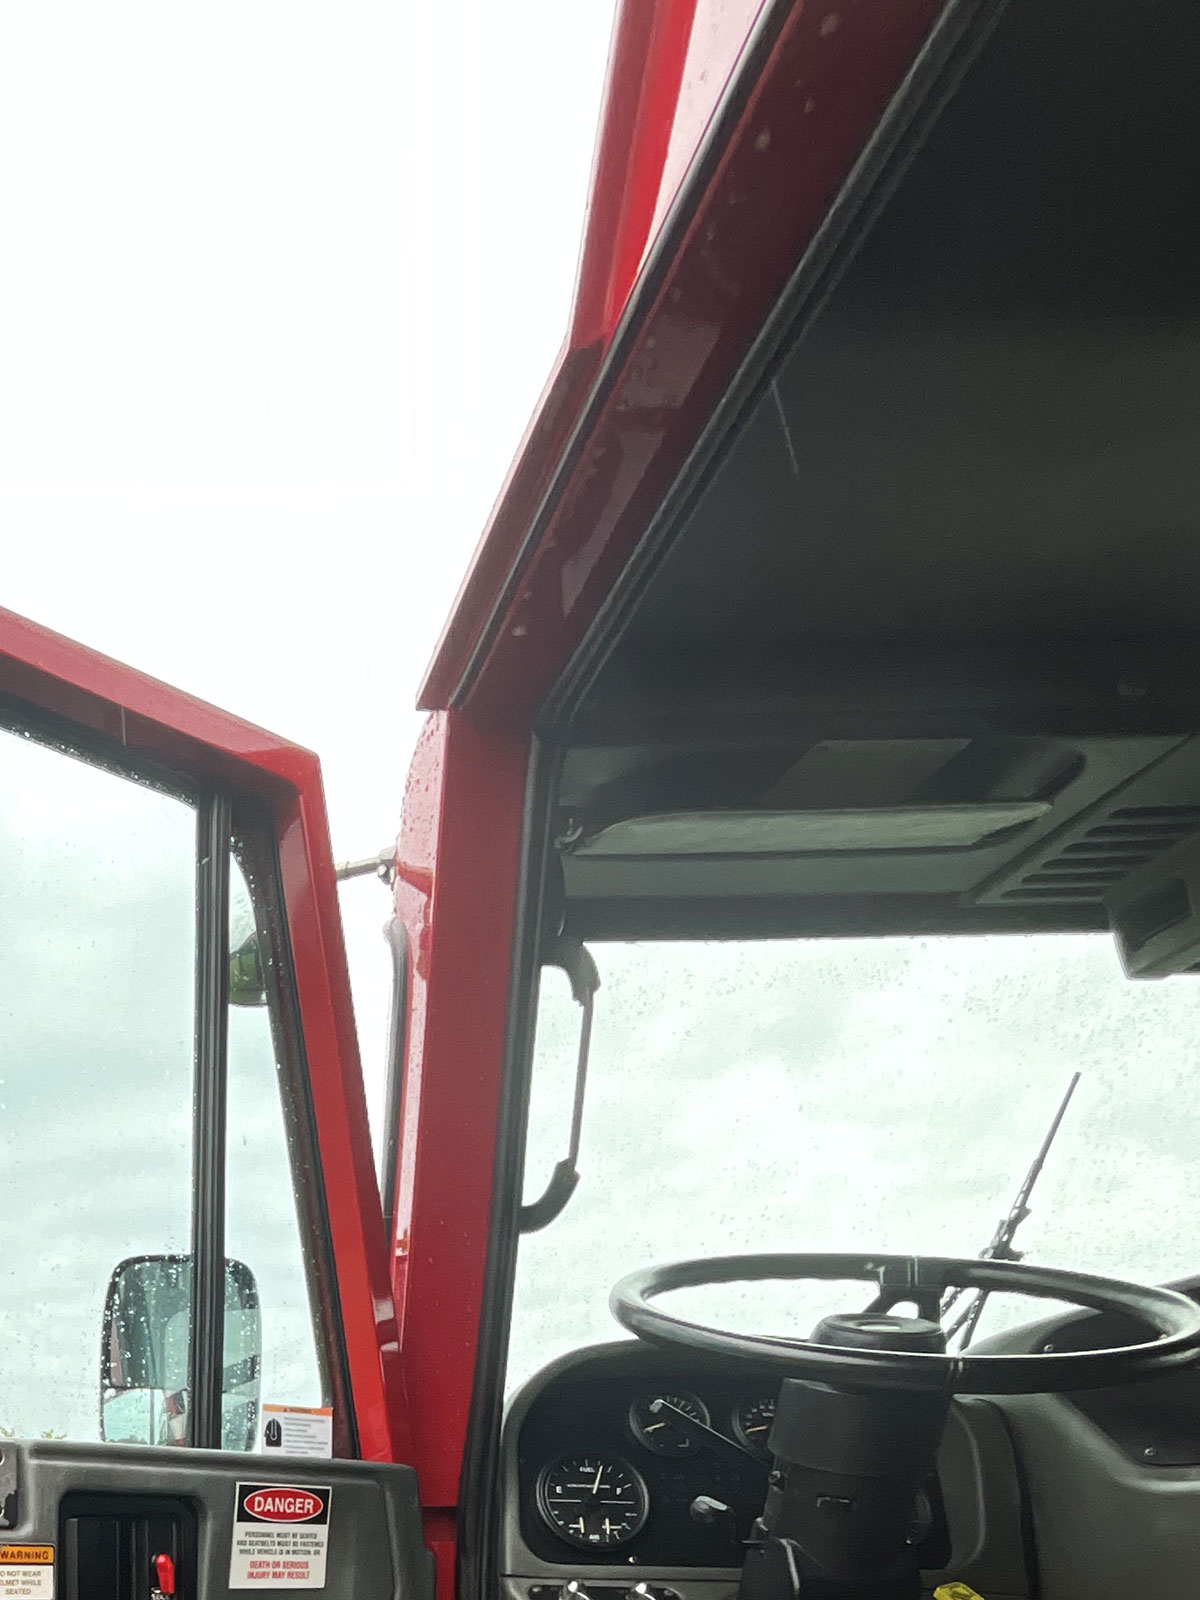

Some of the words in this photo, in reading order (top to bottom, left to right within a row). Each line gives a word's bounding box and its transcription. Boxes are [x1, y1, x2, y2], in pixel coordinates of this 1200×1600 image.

[254, 1496, 314, 1514] DANGER
[1, 1551, 49, 1560] WARNING
[249, 1561, 271, 1569] DEATH
[271, 1561, 281, 1569] OR
[282, 1561, 310, 1569] SERIOUS
[247, 1571, 270, 1579] INJURY
[272, 1571, 286, 1579] MAY
[287, 1571, 310, 1579] RESULT
